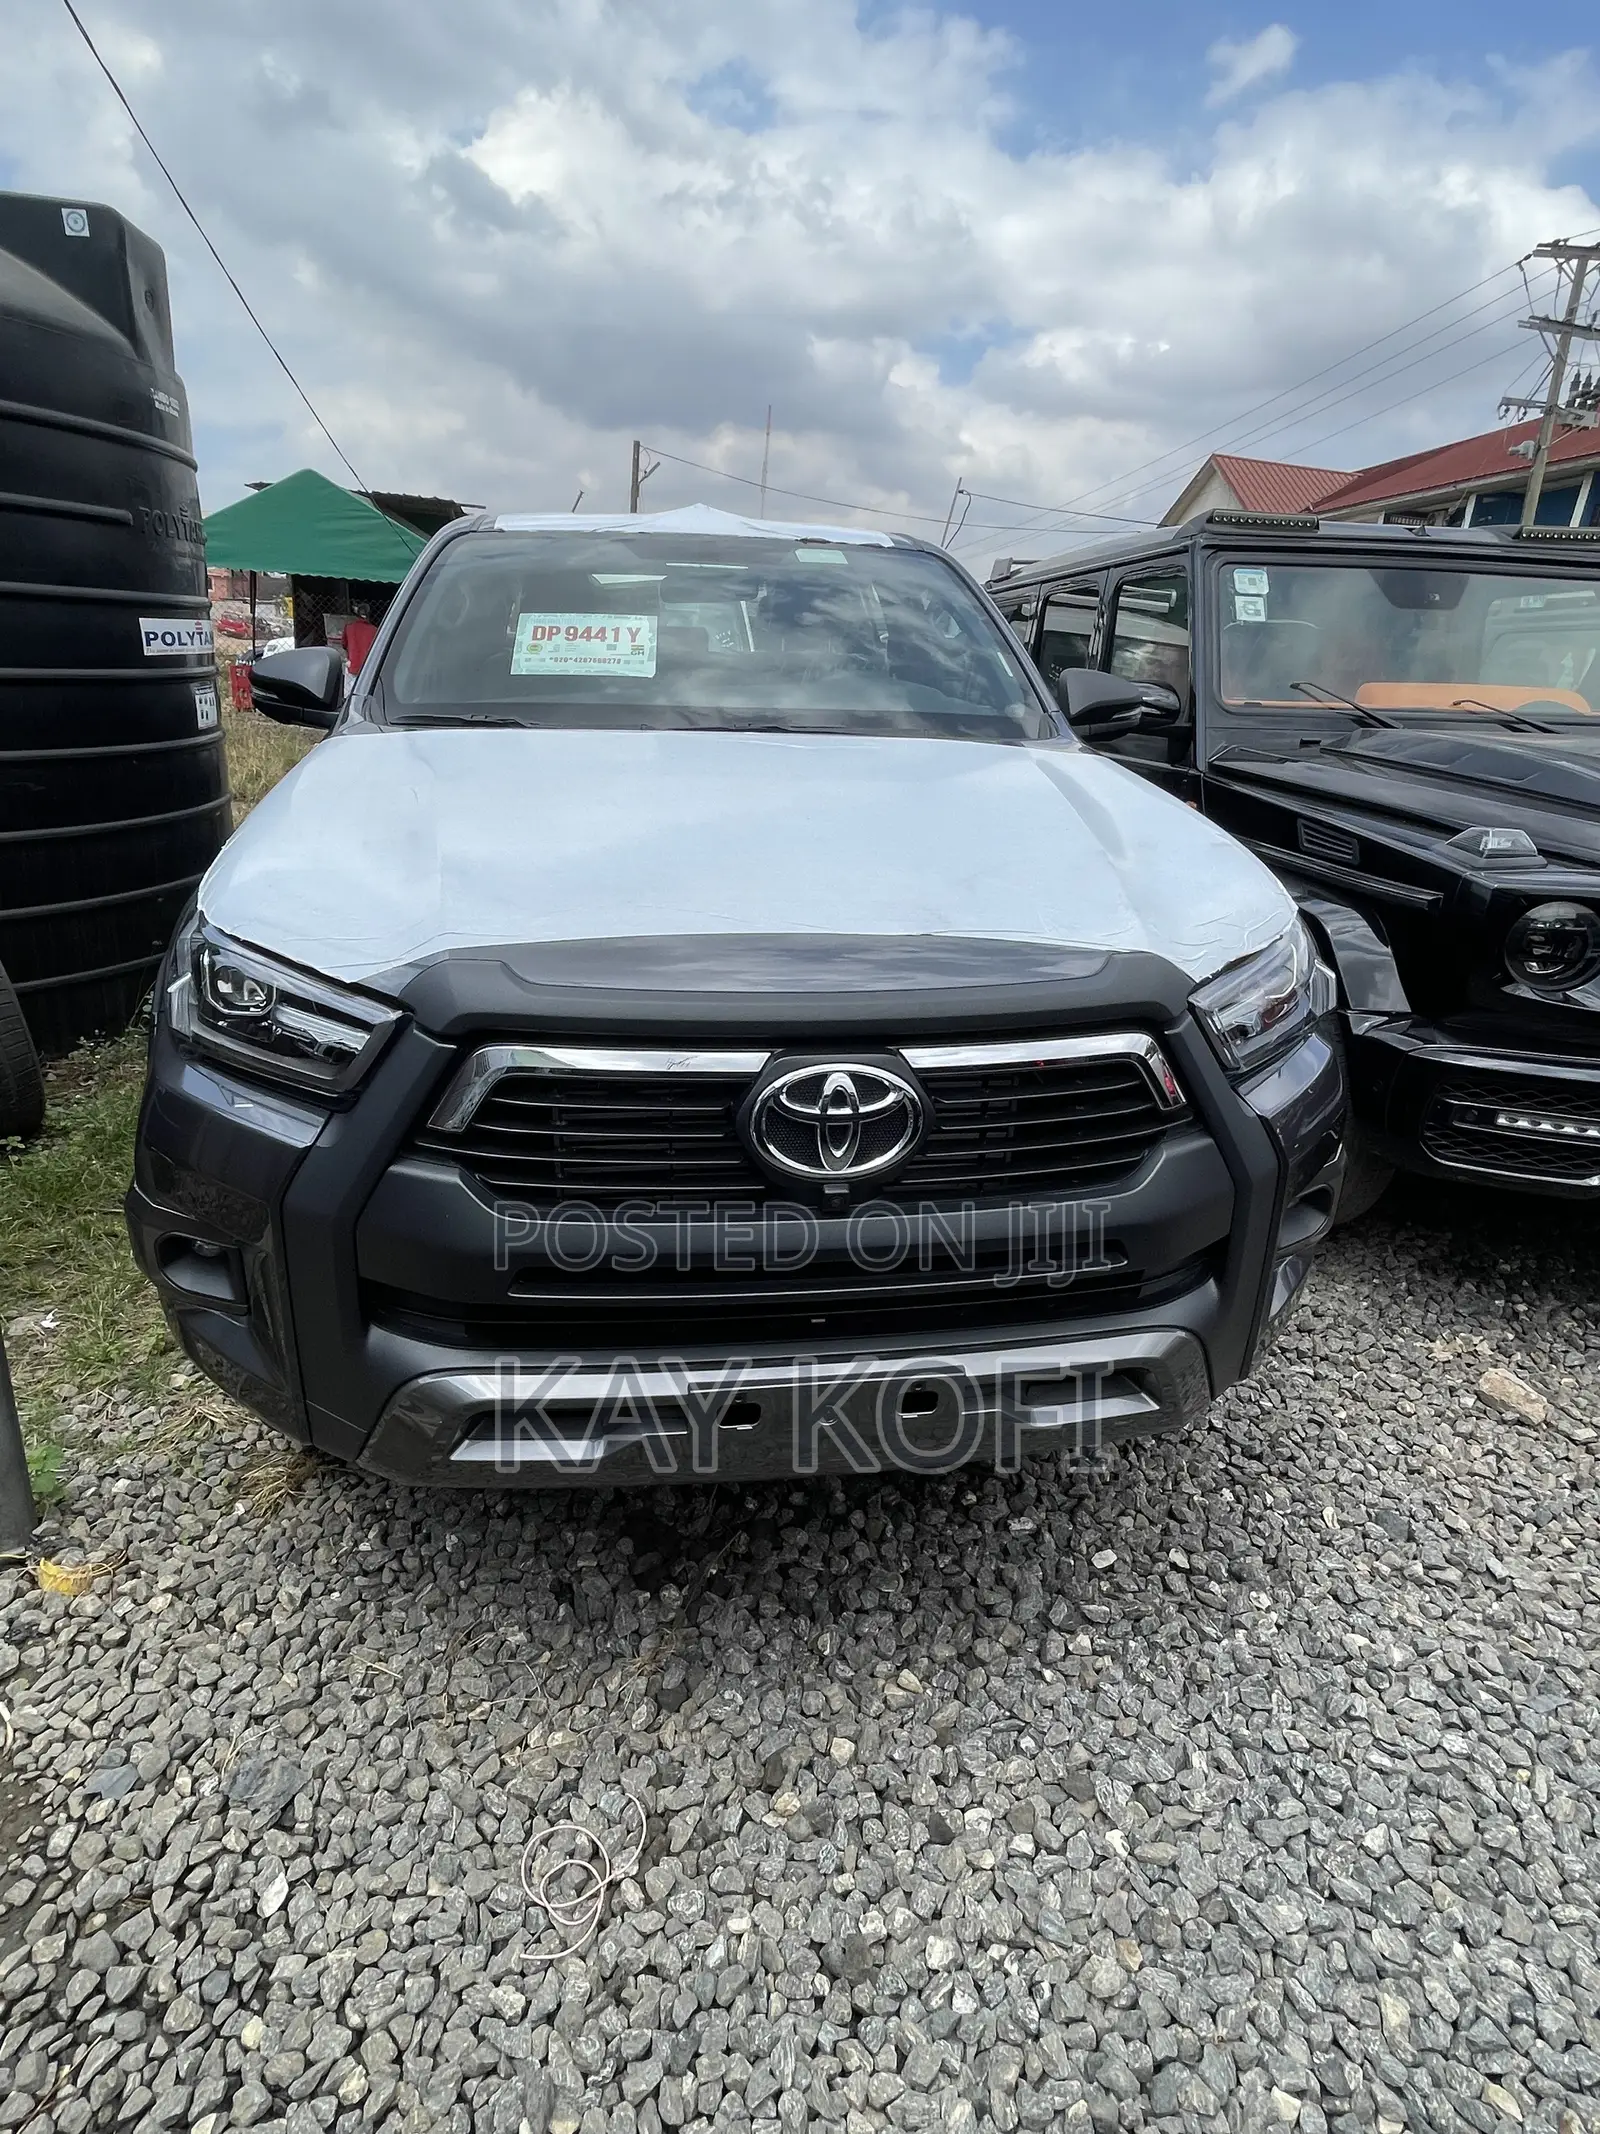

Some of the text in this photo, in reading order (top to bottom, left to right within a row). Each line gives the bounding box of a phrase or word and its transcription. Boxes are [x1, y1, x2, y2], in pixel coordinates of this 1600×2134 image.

[531, 625, 642, 643] DP 9441 Y
